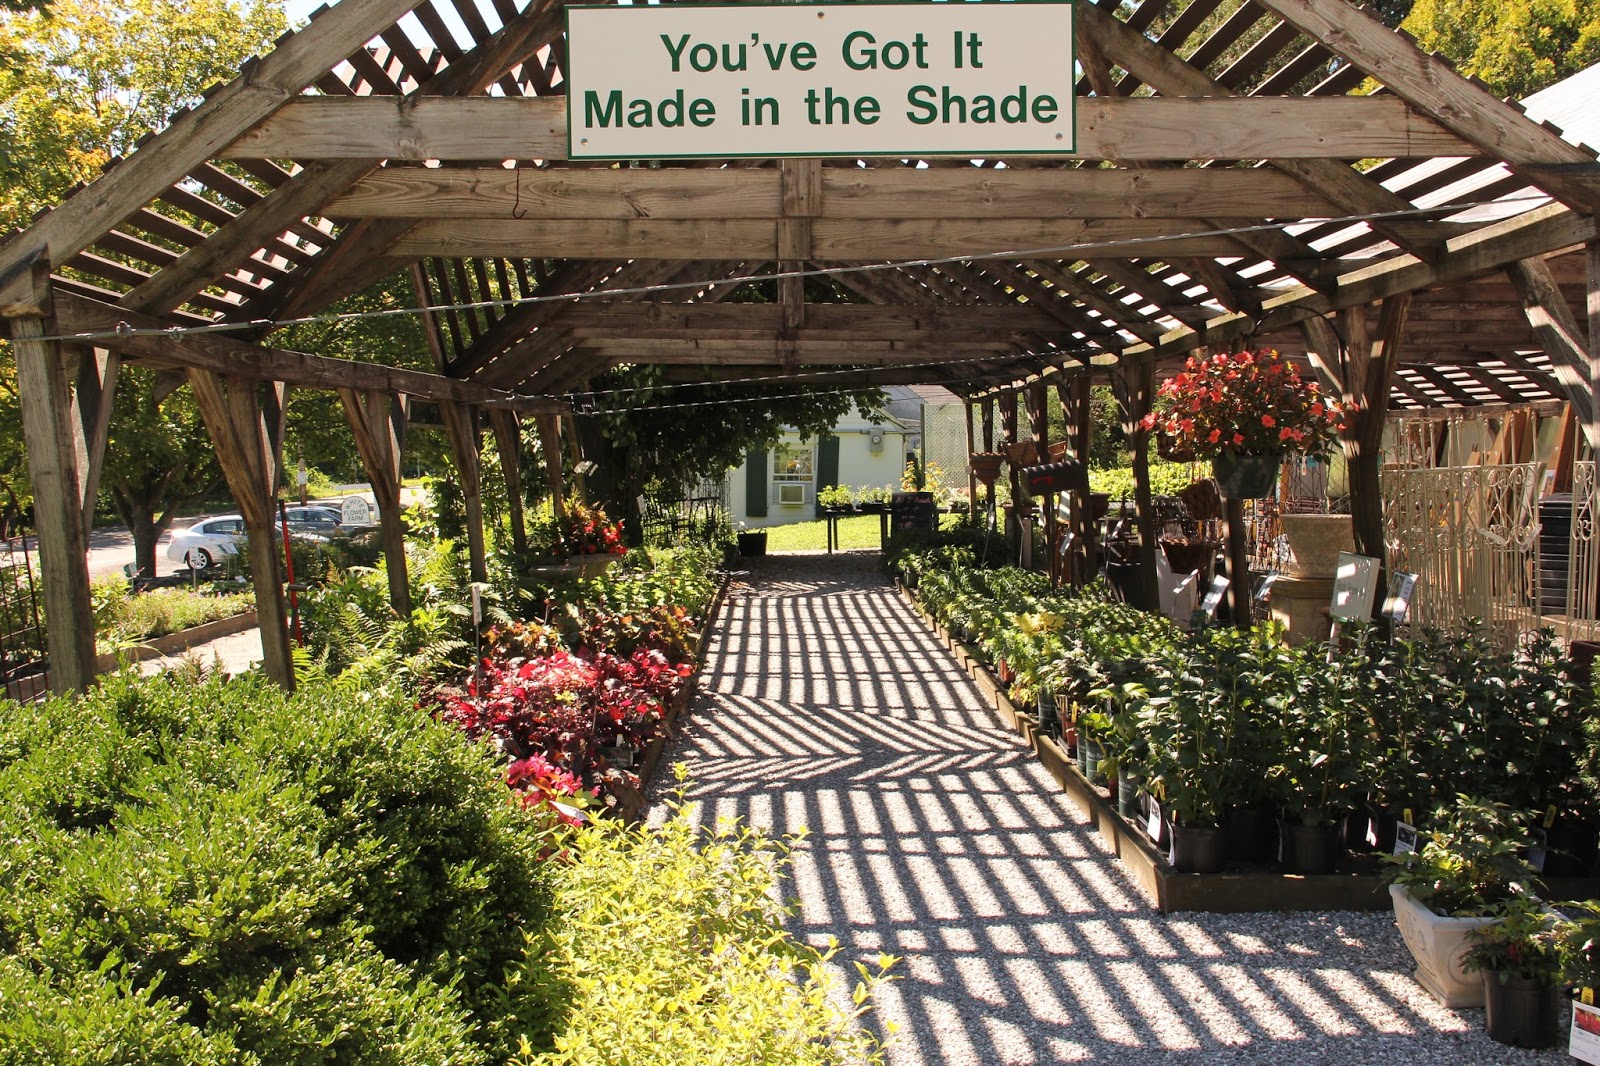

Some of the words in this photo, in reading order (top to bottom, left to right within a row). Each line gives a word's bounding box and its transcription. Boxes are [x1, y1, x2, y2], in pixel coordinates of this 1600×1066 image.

[660, 33, 817, 72] You've
[842, 31, 928, 70] Got
[954, 31, 983, 69] It
[584, 89, 716, 128] Made
[741, 88, 780, 126] in
[803, 87, 881, 125] the
[906, 85, 1059, 124] Shade
[345, 499, 365, 509] WHITE
